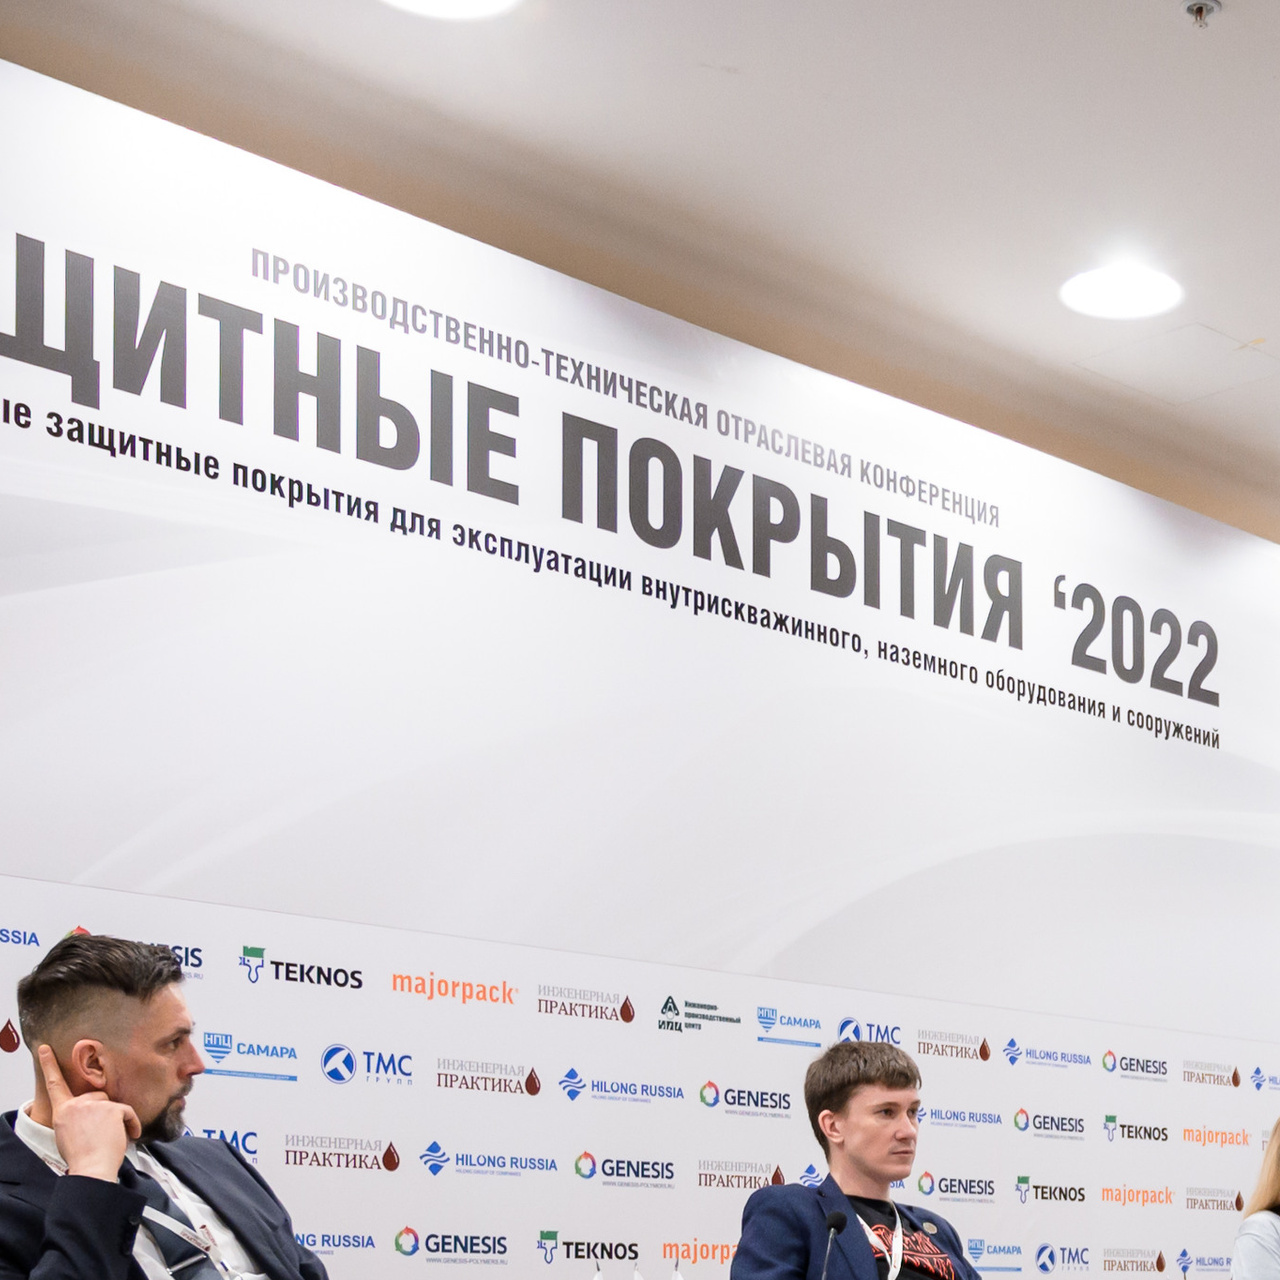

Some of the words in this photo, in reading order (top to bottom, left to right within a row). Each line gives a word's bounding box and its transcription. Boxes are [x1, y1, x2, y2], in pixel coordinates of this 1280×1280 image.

[251, 247, 708, 429] ПРОИЗВОДСТВЕННО-ТЕХНИЧЕСКАЯ
[716, 409, 852, 479] ОТРАСЛЕВАЯ
[859, 458, 1000, 529] КОНФЕРЕНЦИЯ
[562, 411, 1023, 651] ПОКРЫТИЯ
[46, 411, 219, 480] защитные
[233, 461, 379, 523] покрытия
[390, 507, 441, 541] для
[452, 522, 632, 591] эксплуатации
[641, 573, 868, 660] внутрискважинного,
[878, 640, 978, 684] наземного
[986, 669, 1106, 720] оборудования
[1112, 703, 1121, 723] и
[1127, 706, 1220, 750] сооружений
[270, 960, 363, 989] TEKNOS
[392, 972, 514, 1004] majorpack
[537, 984, 620, 1005] ИНЖЕНЕРНАЯ
[537, 998, 620, 1022] ПРАКТИКА
[780, 1015, 821, 1030] САМАРА
[917, 1029, 979, 1046] ИНЖЕНЕРНАЯ
[237, 1042, 297, 1059] САМАРА
[917, 1041, 979, 1060] ПРАКТИКА
[1026, 1048, 1059, 1062] HILONG
[1061, 1052, 1092, 1065] RUSSIA
[437, 1058, 525, 1077] ИНЖЕНЕРНАЯ
[1120, 1056, 1168, 1075] GENESIS
[436, 1073, 524, 1094] ПРАКТИКА
[1183, 1071, 1232, 1086] ПРАКТИКА
[591, 1080, 637, 1095] HILONG
[641, 1084, 684, 1099] RUSSIA
[724, 1089, 791, 1110] GENESIS
[930, 1109, 966, 1122] HILONG
[969, 1112, 1002, 1124] RUSSIA
[1033, 1115, 1084, 1133] GENESIS
[1120, 1124, 1168, 1141] TEKNOS
[1183, 1126, 1250, 1148] majorpack
[285, 1134, 382, 1152] ИНЖЕНЕРНАЯ
[285, 1150, 382, 1170] ПРАКТИКА
[455, 1153, 506, 1168] HILONG
[510, 1156, 558, 1171] RUSSIA
[602, 1158, 675, 1179] GENESIS
[698, 1159, 772, 1174] ИНЖЕНЕРНАЯ
[698, 1173, 770, 1190] ПРАКТИКА
[938, 1177, 994, 1195] GENESIS
[1033, 1185, 1085, 1202] TEKNOS
[1102, 1184, 1173, 1207] majorpack
[1186, 1198, 1235, 1211] ПРАКТИКА
[321, 1234, 375, 1248] RUSSIA
[425, 1233, 507, 1255] GENESIS
[987, 1245, 1022, 1255] САМАРА
[562, 1241, 639, 1260] TEKNOS
[1103, 1259, 1156, 1272] ПРАКТИКА
[1196, 1256, 1223, 1267] HILONG
